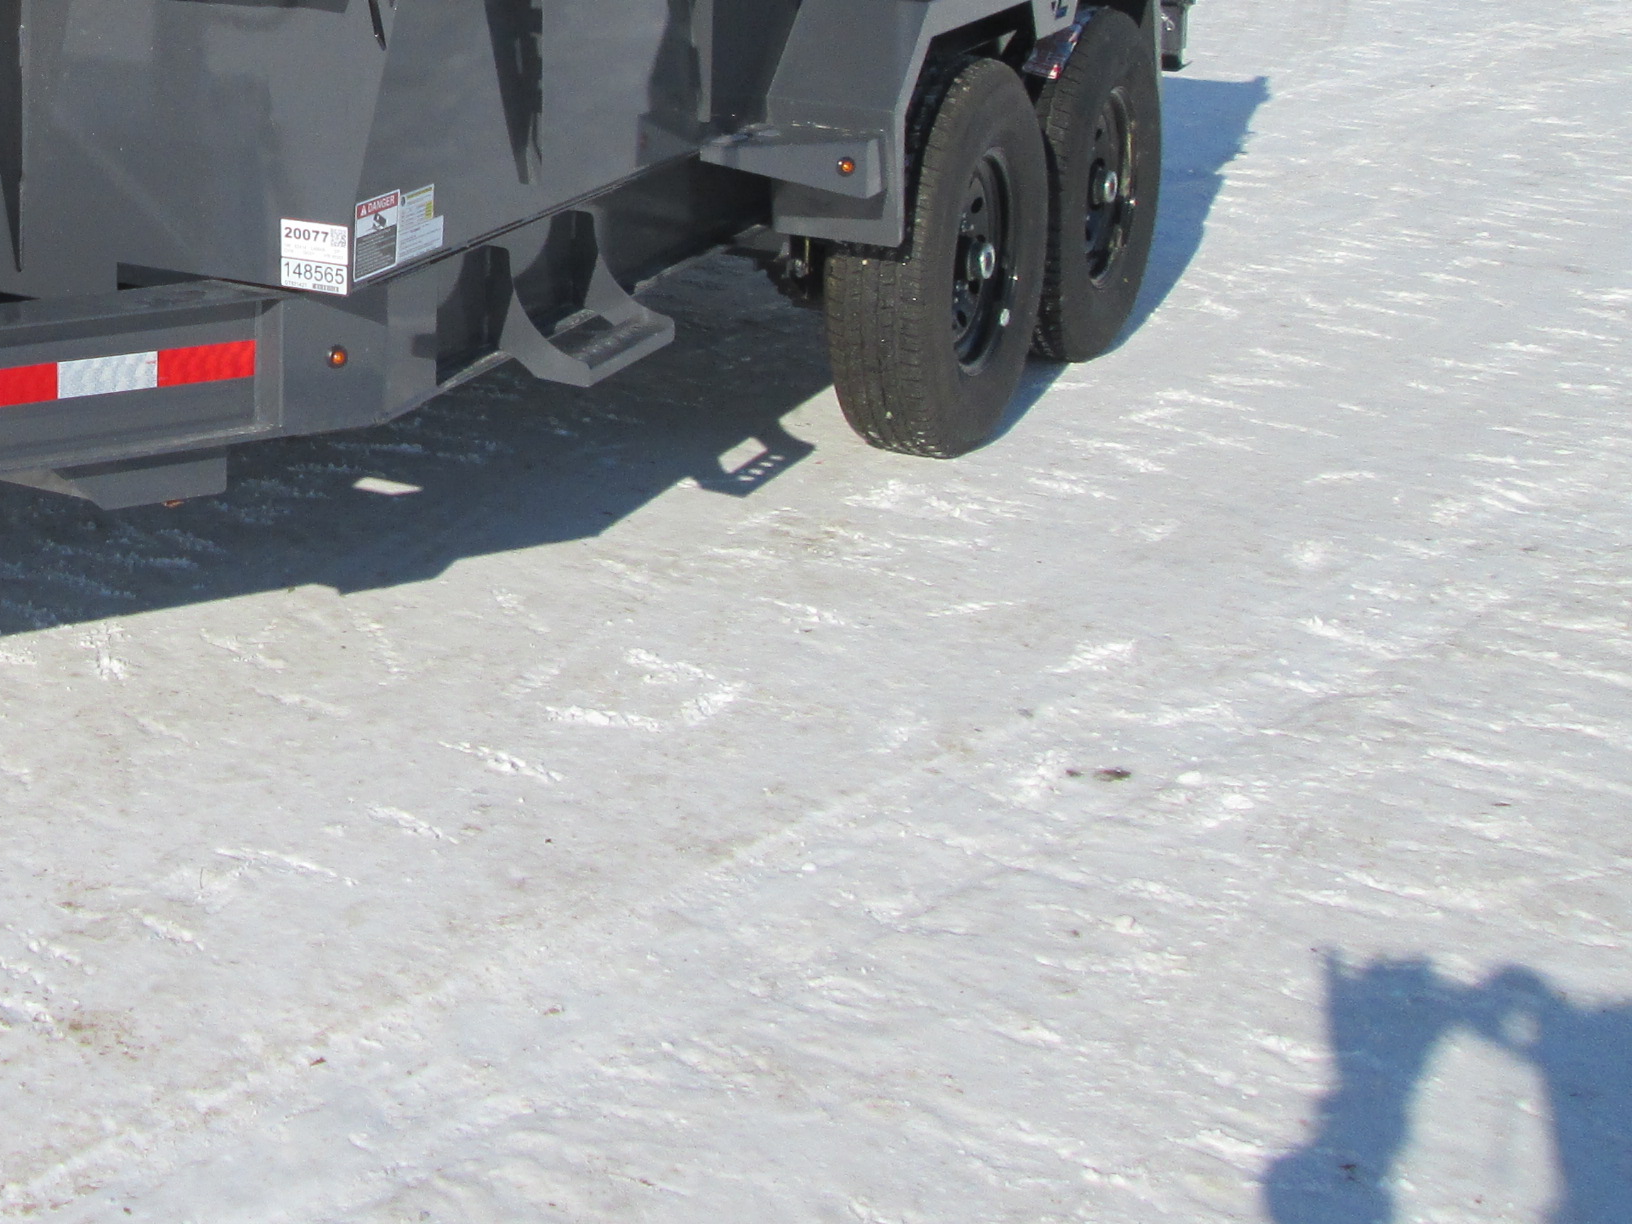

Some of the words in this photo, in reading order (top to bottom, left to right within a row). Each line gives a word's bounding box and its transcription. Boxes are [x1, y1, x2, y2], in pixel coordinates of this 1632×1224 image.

[368, 195, 395, 213] DANGER
[284, 227, 329, 243] 20077
[284, 261, 345, 285] 148565
